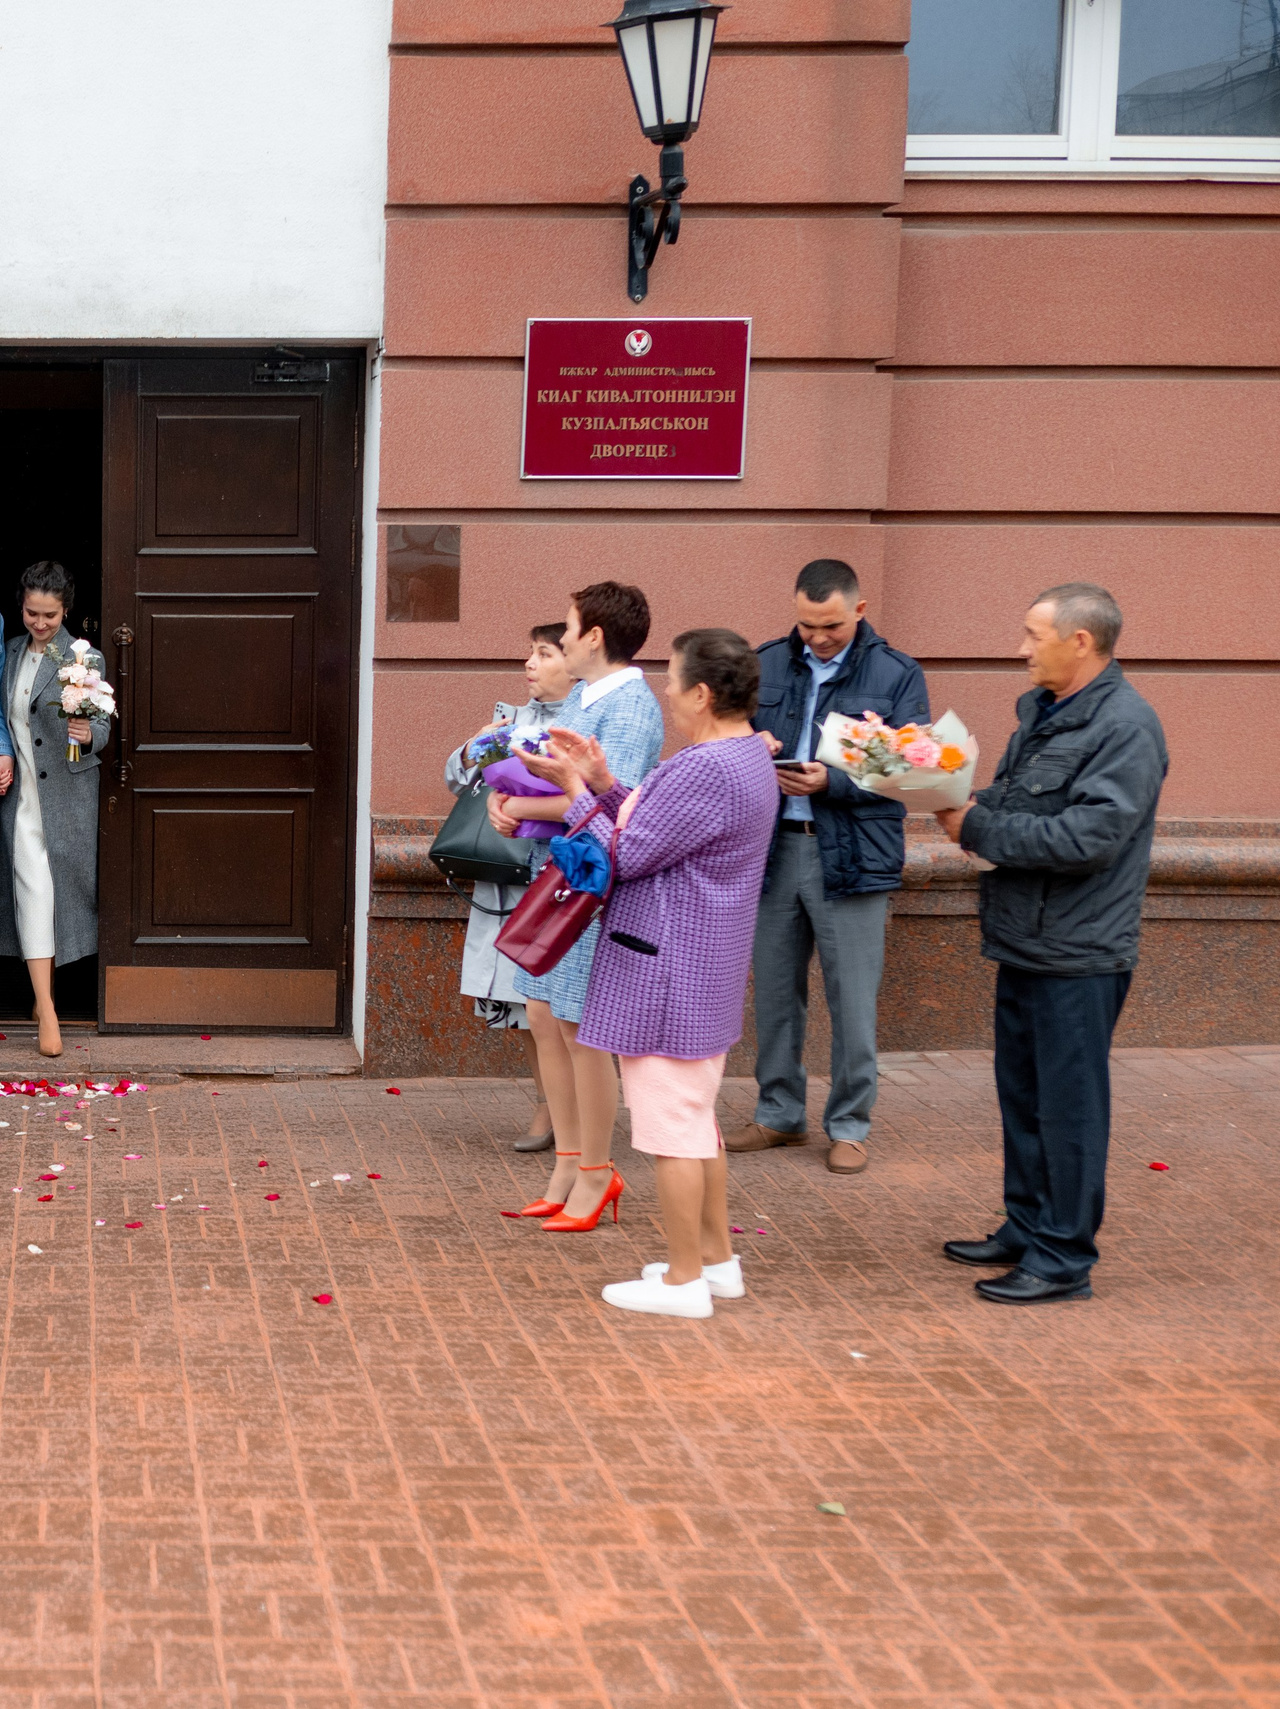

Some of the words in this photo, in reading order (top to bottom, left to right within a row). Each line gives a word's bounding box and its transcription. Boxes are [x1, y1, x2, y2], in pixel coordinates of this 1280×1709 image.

[559, 367, 598, 376] ИЖКАР
[604, 367, 716, 377] АДМИНИСТРАИЫСЬ
[537, 390, 582, 403] КИАГ
[585, 390, 736, 403] КИВАЛТОННИЛЭН
[561, 417, 709, 430] КУЗПАЛЪЯСЬКОН
